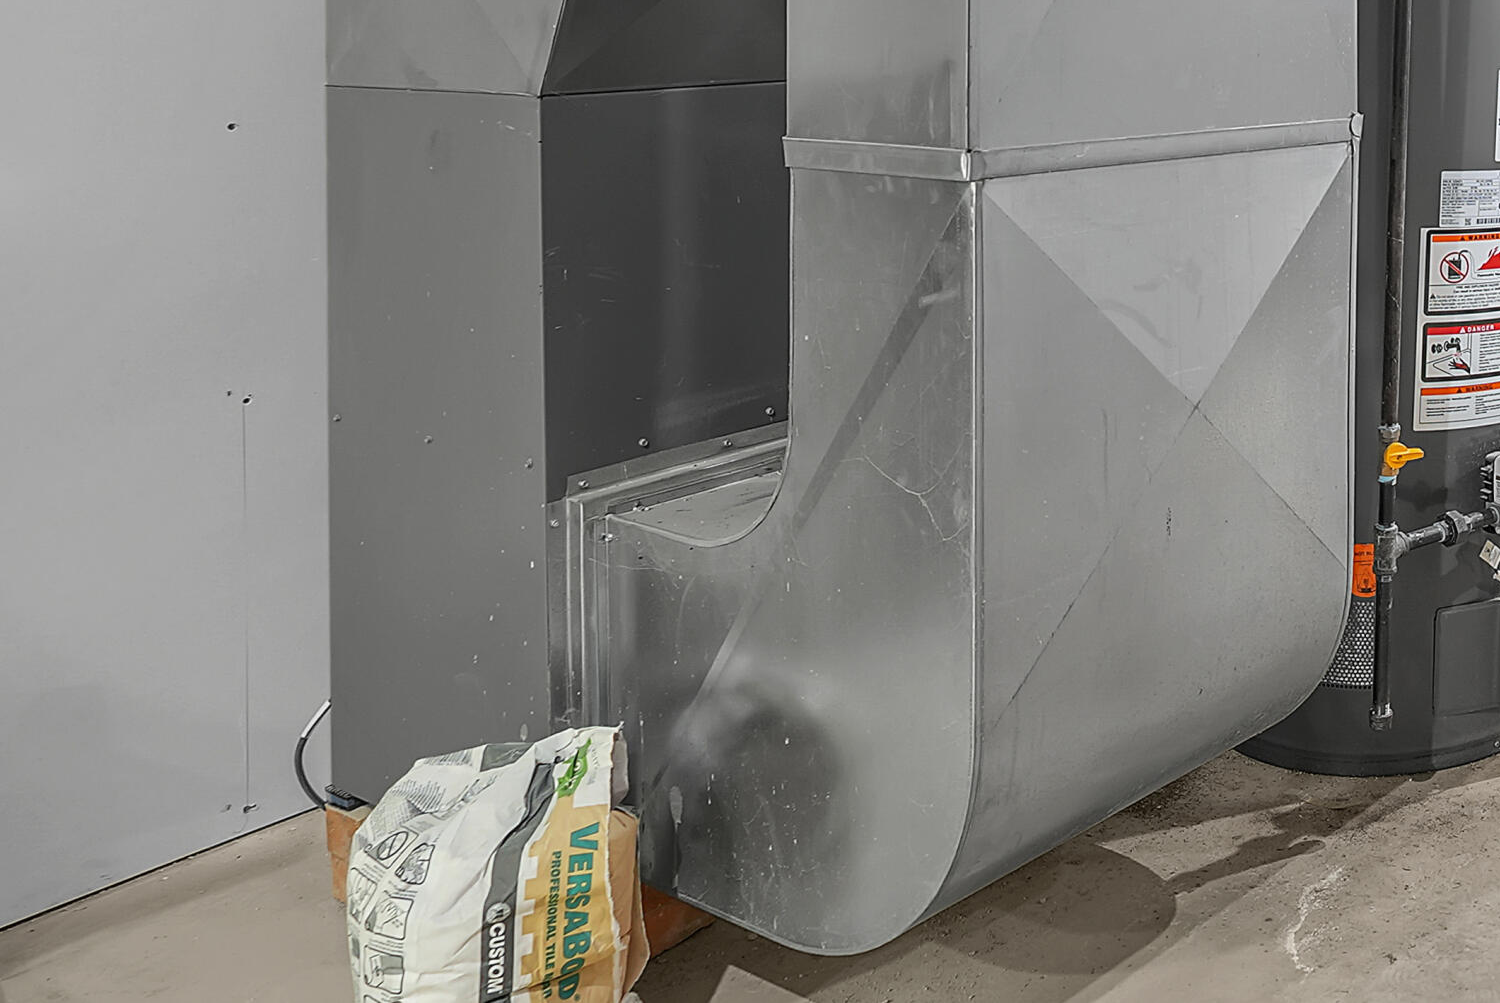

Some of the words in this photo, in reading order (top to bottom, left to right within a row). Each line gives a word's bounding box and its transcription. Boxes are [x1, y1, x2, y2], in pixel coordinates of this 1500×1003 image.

[1468, 233, 1500, 241] WARNING
[1467, 324, 1495, 333] DANGER
[487, 923, 506, 994] CUSTOM
[544, 943, 556, 970] TILE
